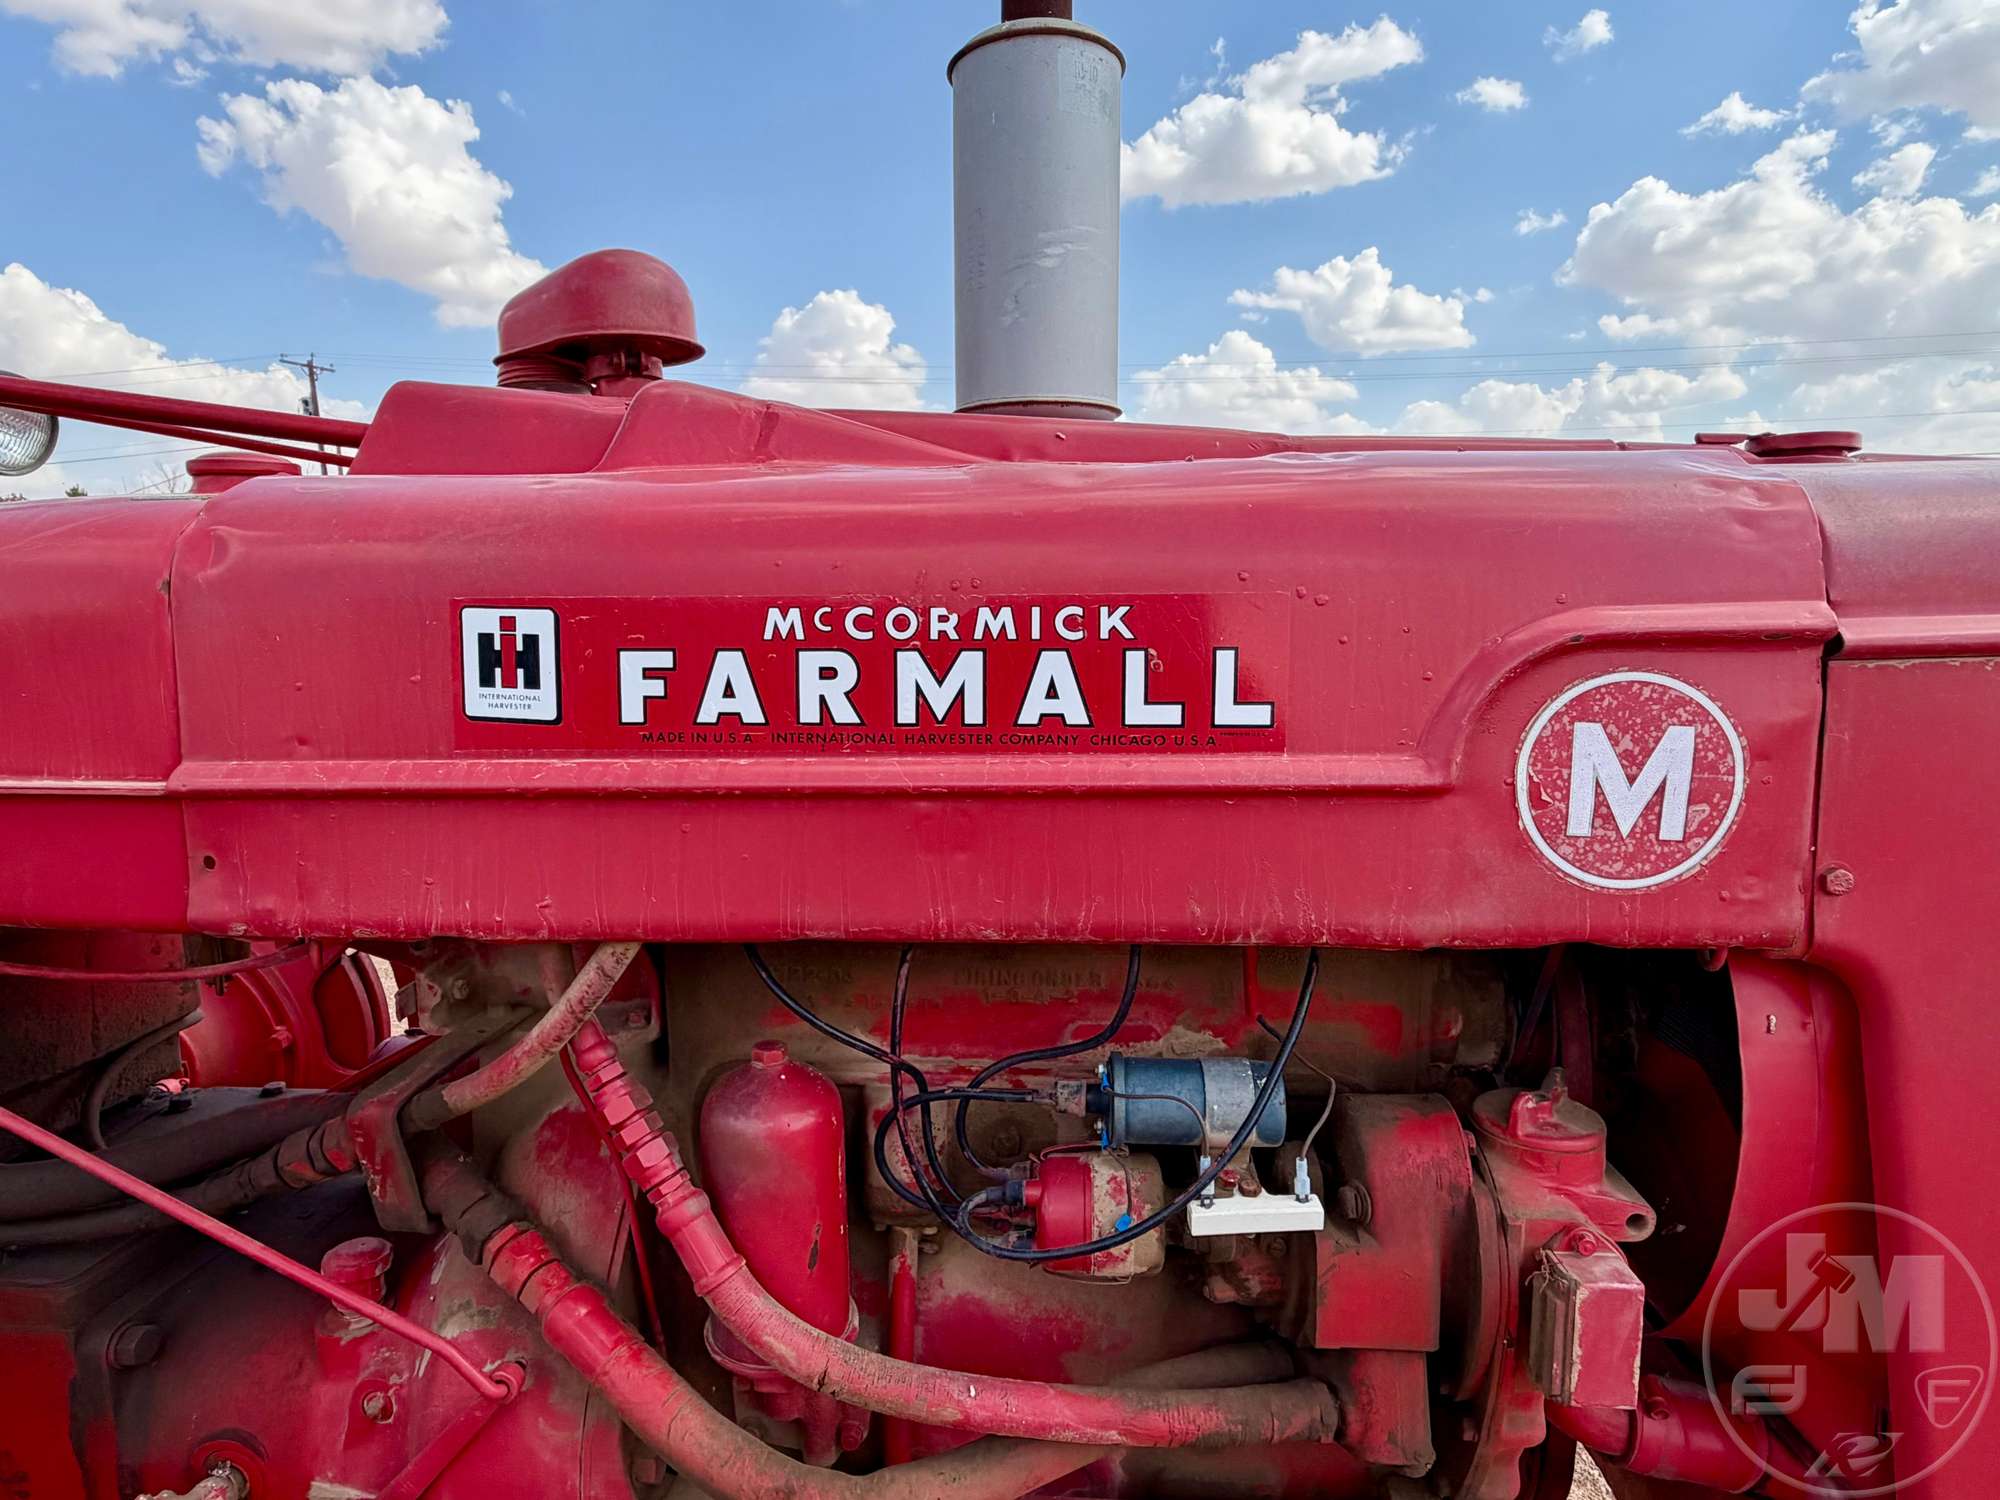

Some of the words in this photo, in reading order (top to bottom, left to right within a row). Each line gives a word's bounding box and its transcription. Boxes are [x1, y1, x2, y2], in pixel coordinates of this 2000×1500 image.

[617, 647, 1275, 728] FARMALL
[478, 692, 542, 702] INTERNATIONAL
[487, 702, 533, 711] HARVESTER
[640, 731, 686, 744] MADE
[691, 732, 708, 744] IN
[771, 732, 896, 745] INTERNATIONAL
[904, 733, 993, 745] HARVESTER
[999, 733, 1080, 746] COMPANY
[1089, 734, 1167, 747] CHICAGO
[1566, 721, 1696, 841] M
